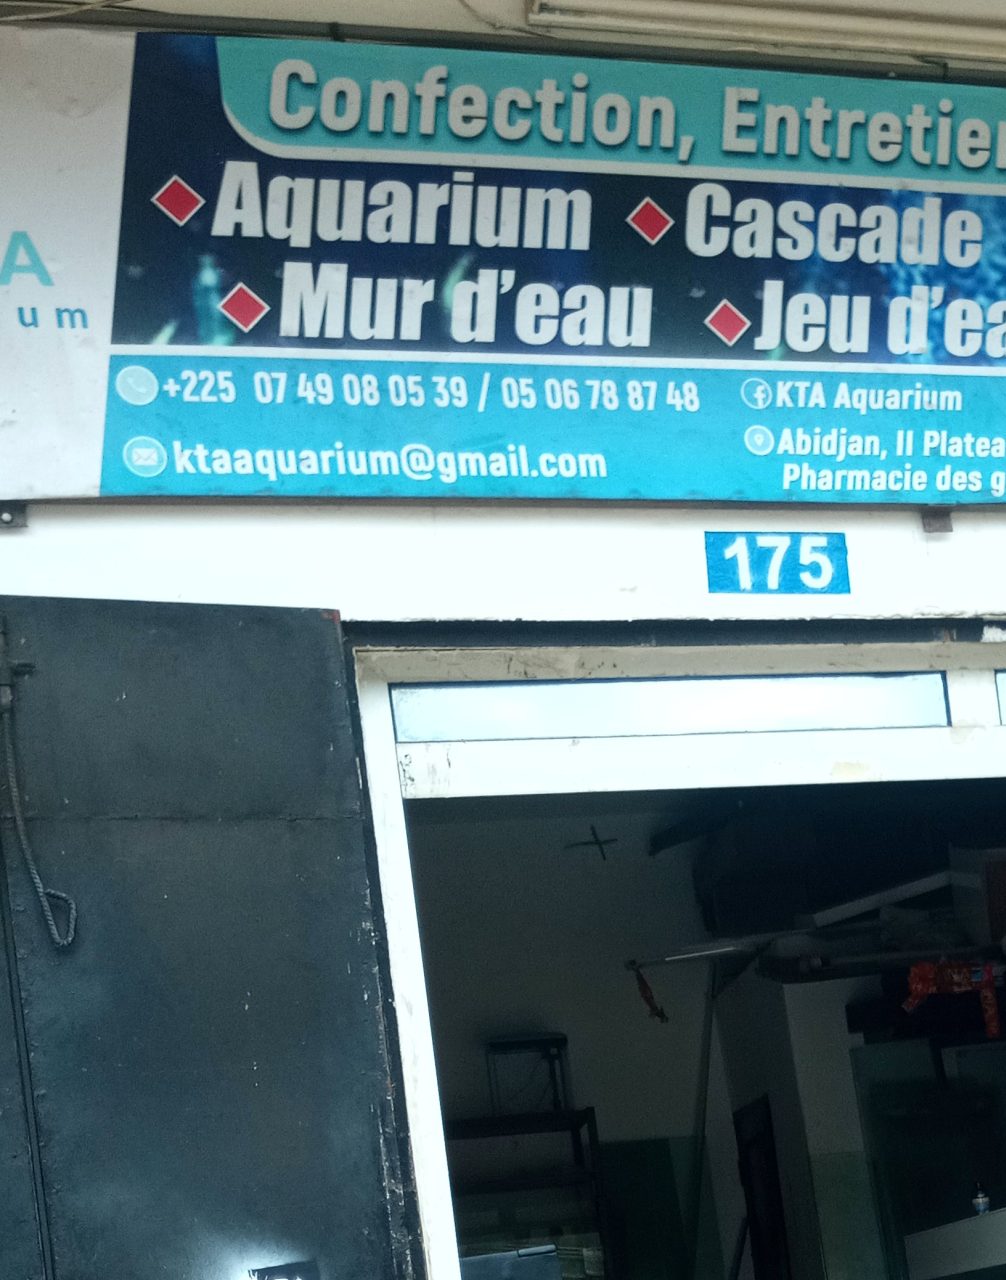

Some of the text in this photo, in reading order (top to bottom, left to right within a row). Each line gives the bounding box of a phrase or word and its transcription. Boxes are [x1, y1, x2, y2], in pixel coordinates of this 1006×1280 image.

[267, 58, 694, 163] Confection,
[210, 160, 593, 250] Aquarium
[685, 182, 984, 269] Cascade
[279, 260, 654, 348] Mur d'eau
[754, 279, 871, 355] Jeu
[162, 370, 700, 412] +225 07 49 08 05 39 / 05 06 78 87 48
[776, 383, 963, 414] KTA Aquarium
[173, 441, 608, 484] ktaaquarium@gmail.com
[777, 428, 888, 461] Abidjan,
[782, 464, 928, 493] Pharmacie
[935, 466, 984, 493] des
[722, 535, 836, 590] 175
